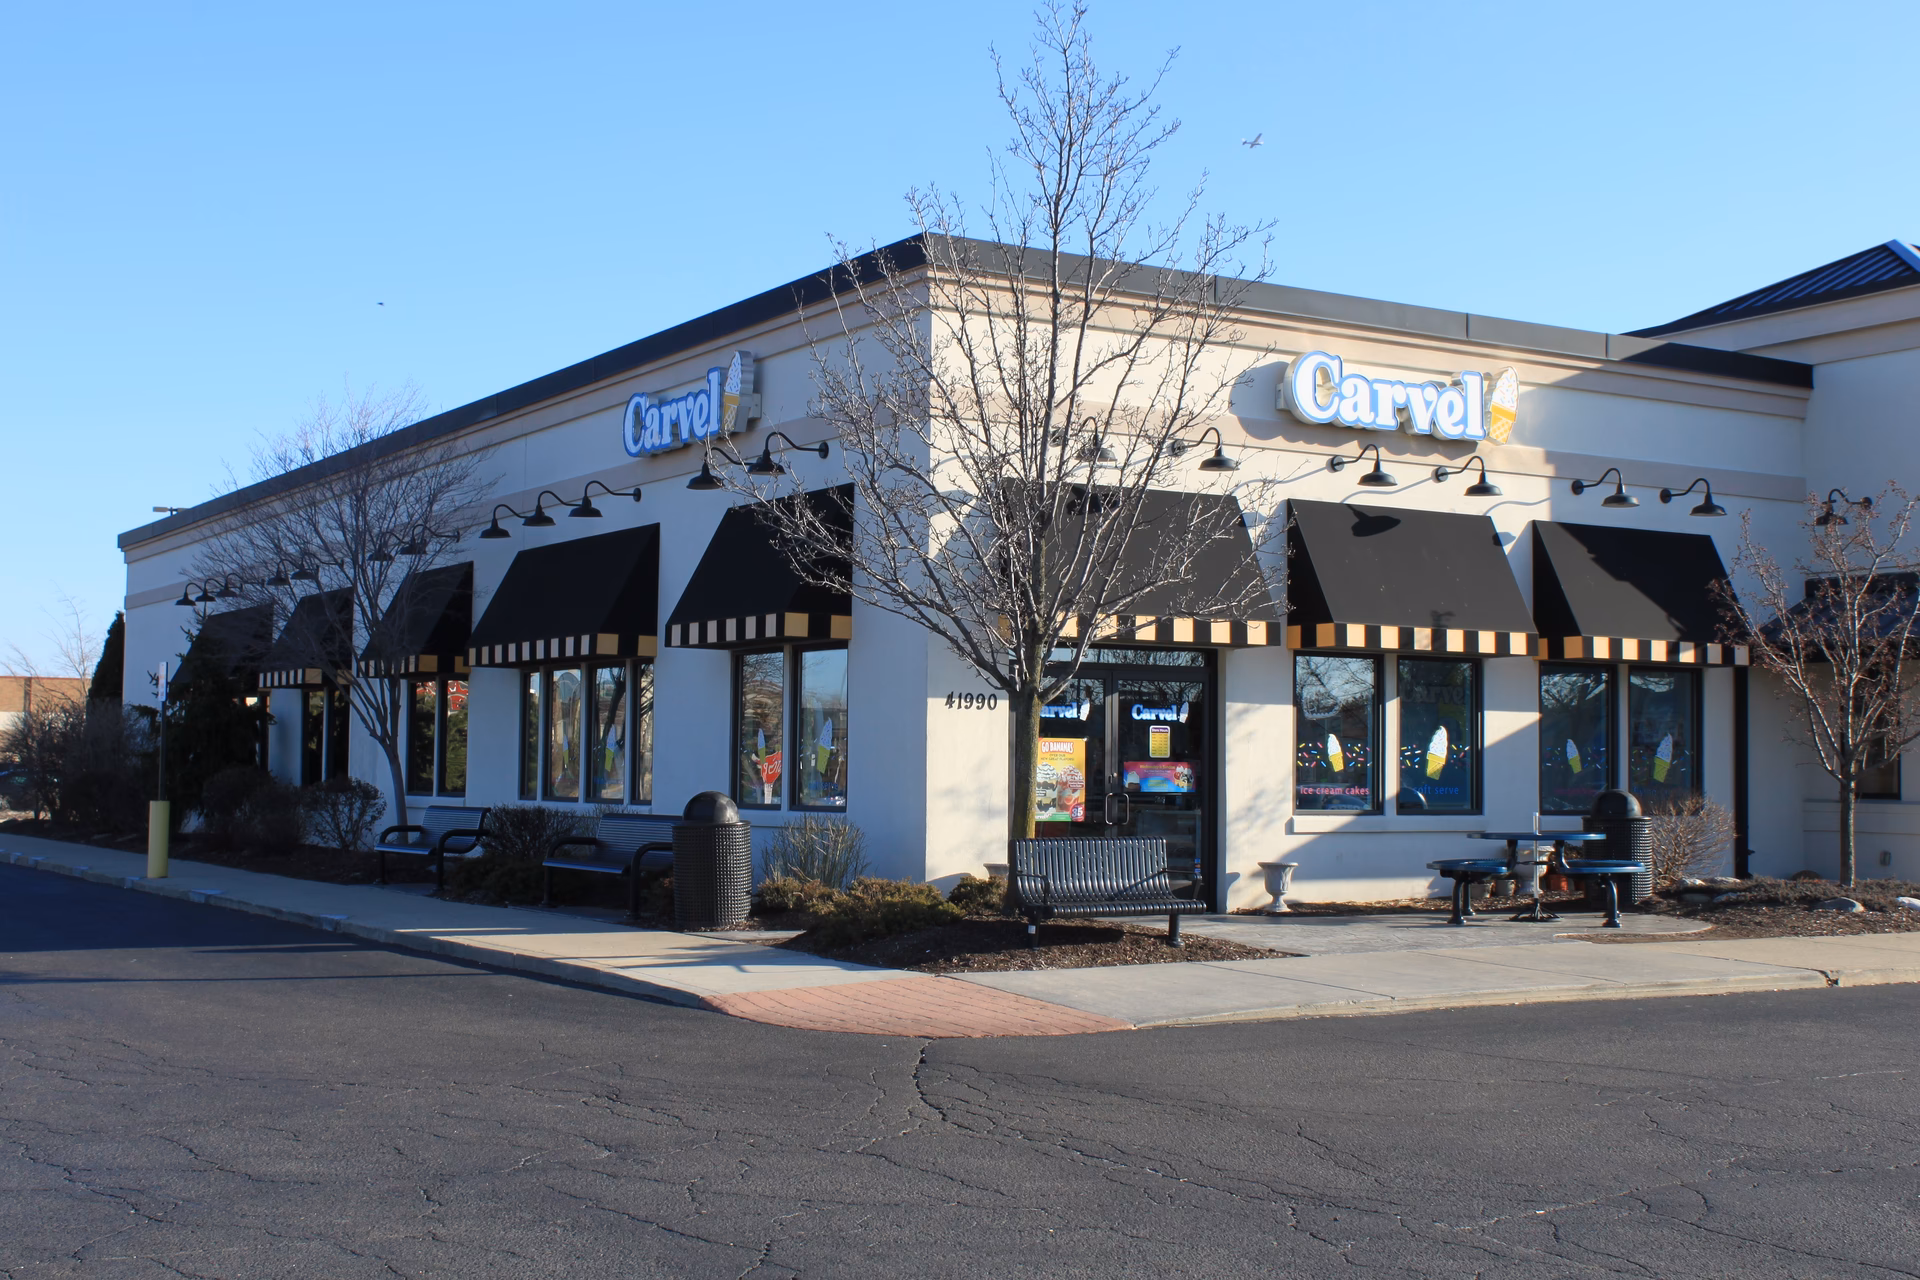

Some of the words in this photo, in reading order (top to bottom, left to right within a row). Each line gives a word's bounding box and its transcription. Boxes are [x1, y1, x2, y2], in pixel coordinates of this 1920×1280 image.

[1293, 351, 1486, 440] Carvel
[623, 366, 721, 457] Carvel
[945, 691, 998, 711] 41990
[1040, 702, 1078, 718] arvel
[1131, 703, 1178, 721] Carvel
[1041, 742, 1050, 753] GO
[1050, 742, 1074, 754] BANANAS
[1300, 785, 1313, 795] ice
[1315, 787, 1342, 795] cream
[1345, 785, 1370, 795] cakes
[1435, 786, 1459, 795] serve
